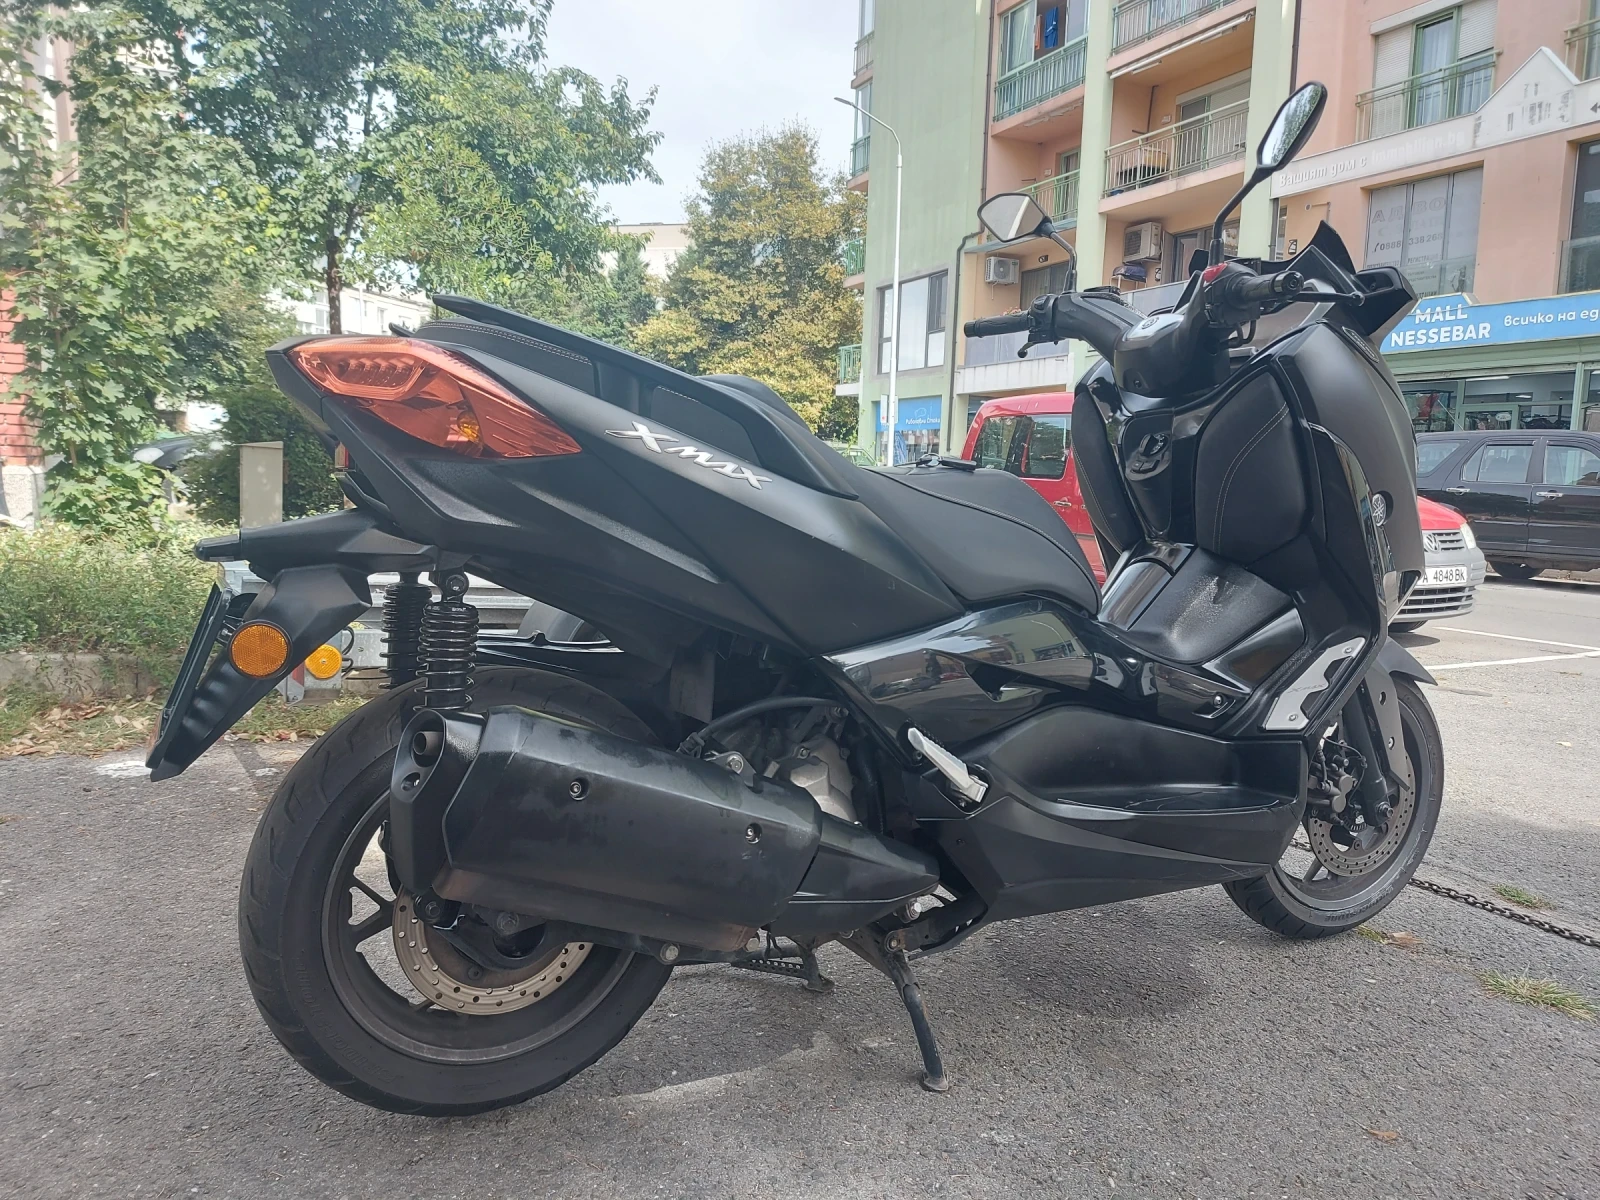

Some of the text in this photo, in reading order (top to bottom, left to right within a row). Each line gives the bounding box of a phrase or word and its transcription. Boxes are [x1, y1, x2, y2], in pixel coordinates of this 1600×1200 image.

[1279, 167, 1328, 188] Вашият
[1331, 160, 1356, 177] дом
[1415, 304, 1468, 324] MALL
[1503, 312, 1553, 327] всичко
[1558, 310, 1576, 322] на
[1390, 323, 1491, 347] NESSEBAR
